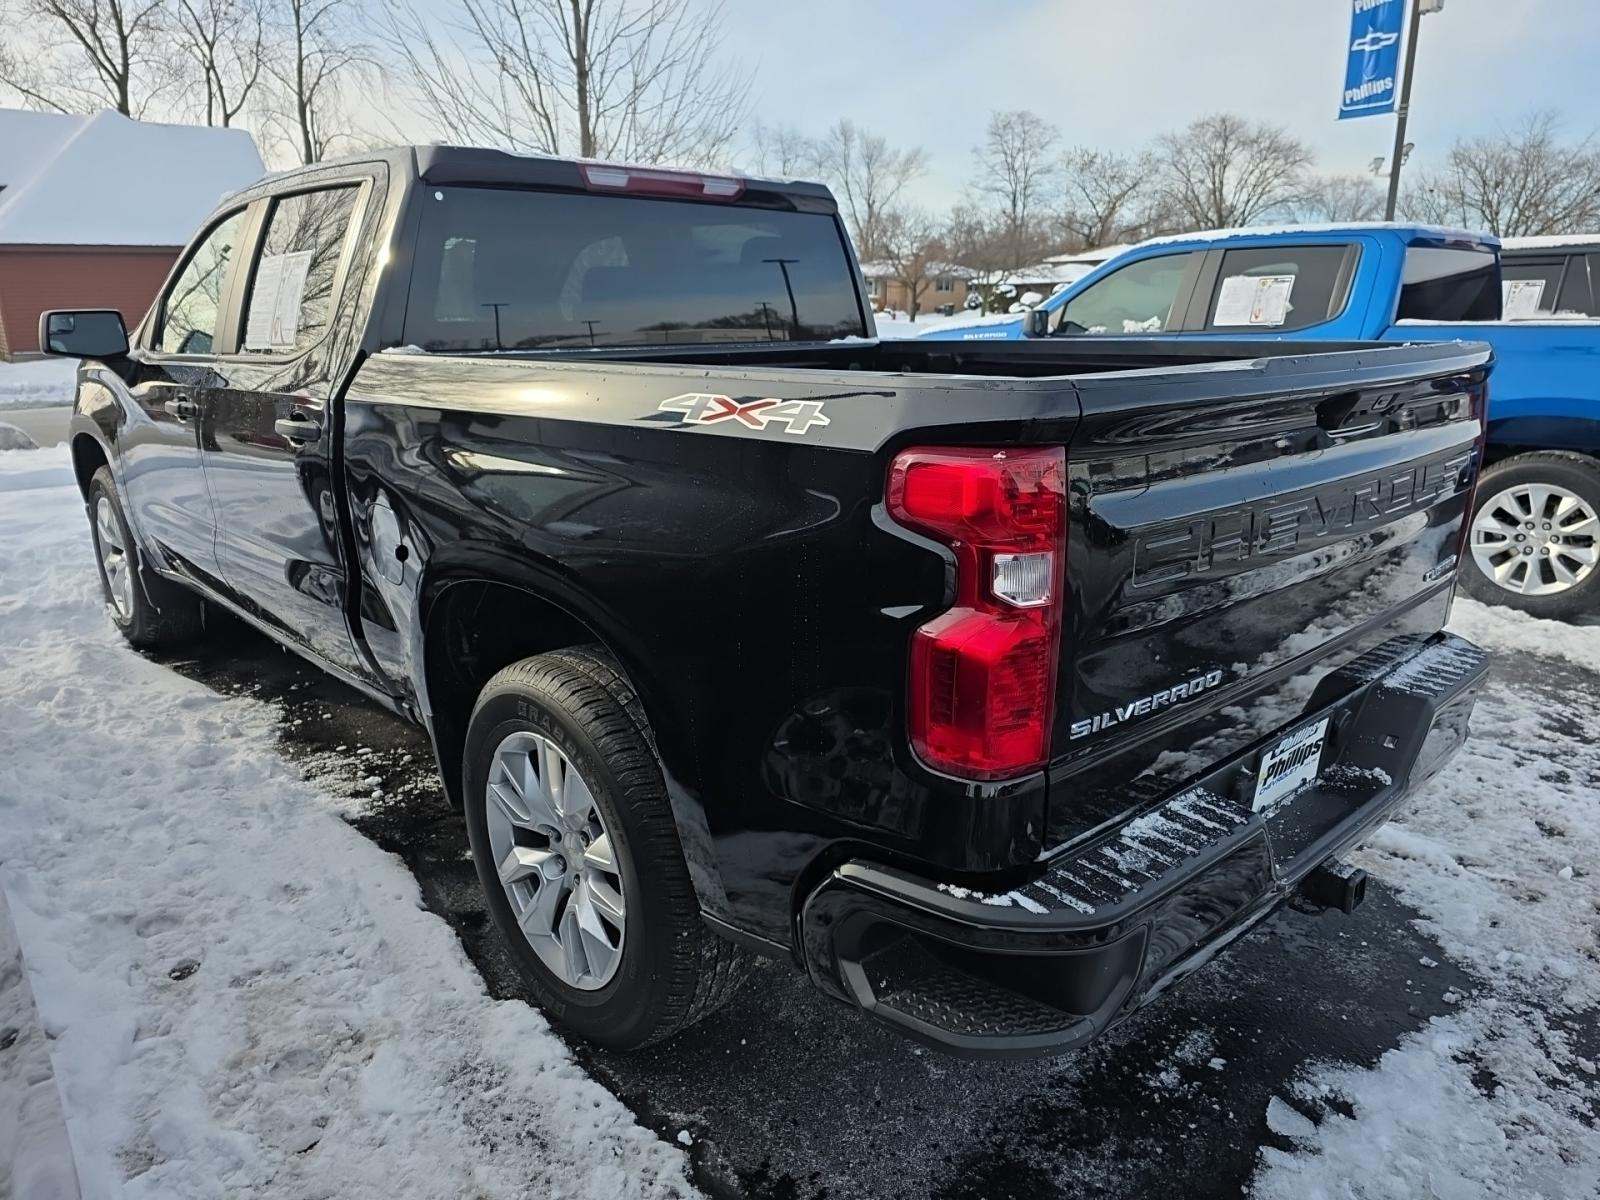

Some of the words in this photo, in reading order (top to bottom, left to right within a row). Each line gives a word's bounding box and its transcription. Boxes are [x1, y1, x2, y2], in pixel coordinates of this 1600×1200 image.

[1344, 77, 1394, 104] Phillips
[1132, 450, 1477, 588] CHEVROLET
[1069, 669, 1223, 741] SILVERADO
[1261, 737, 1325, 787] Phillips
